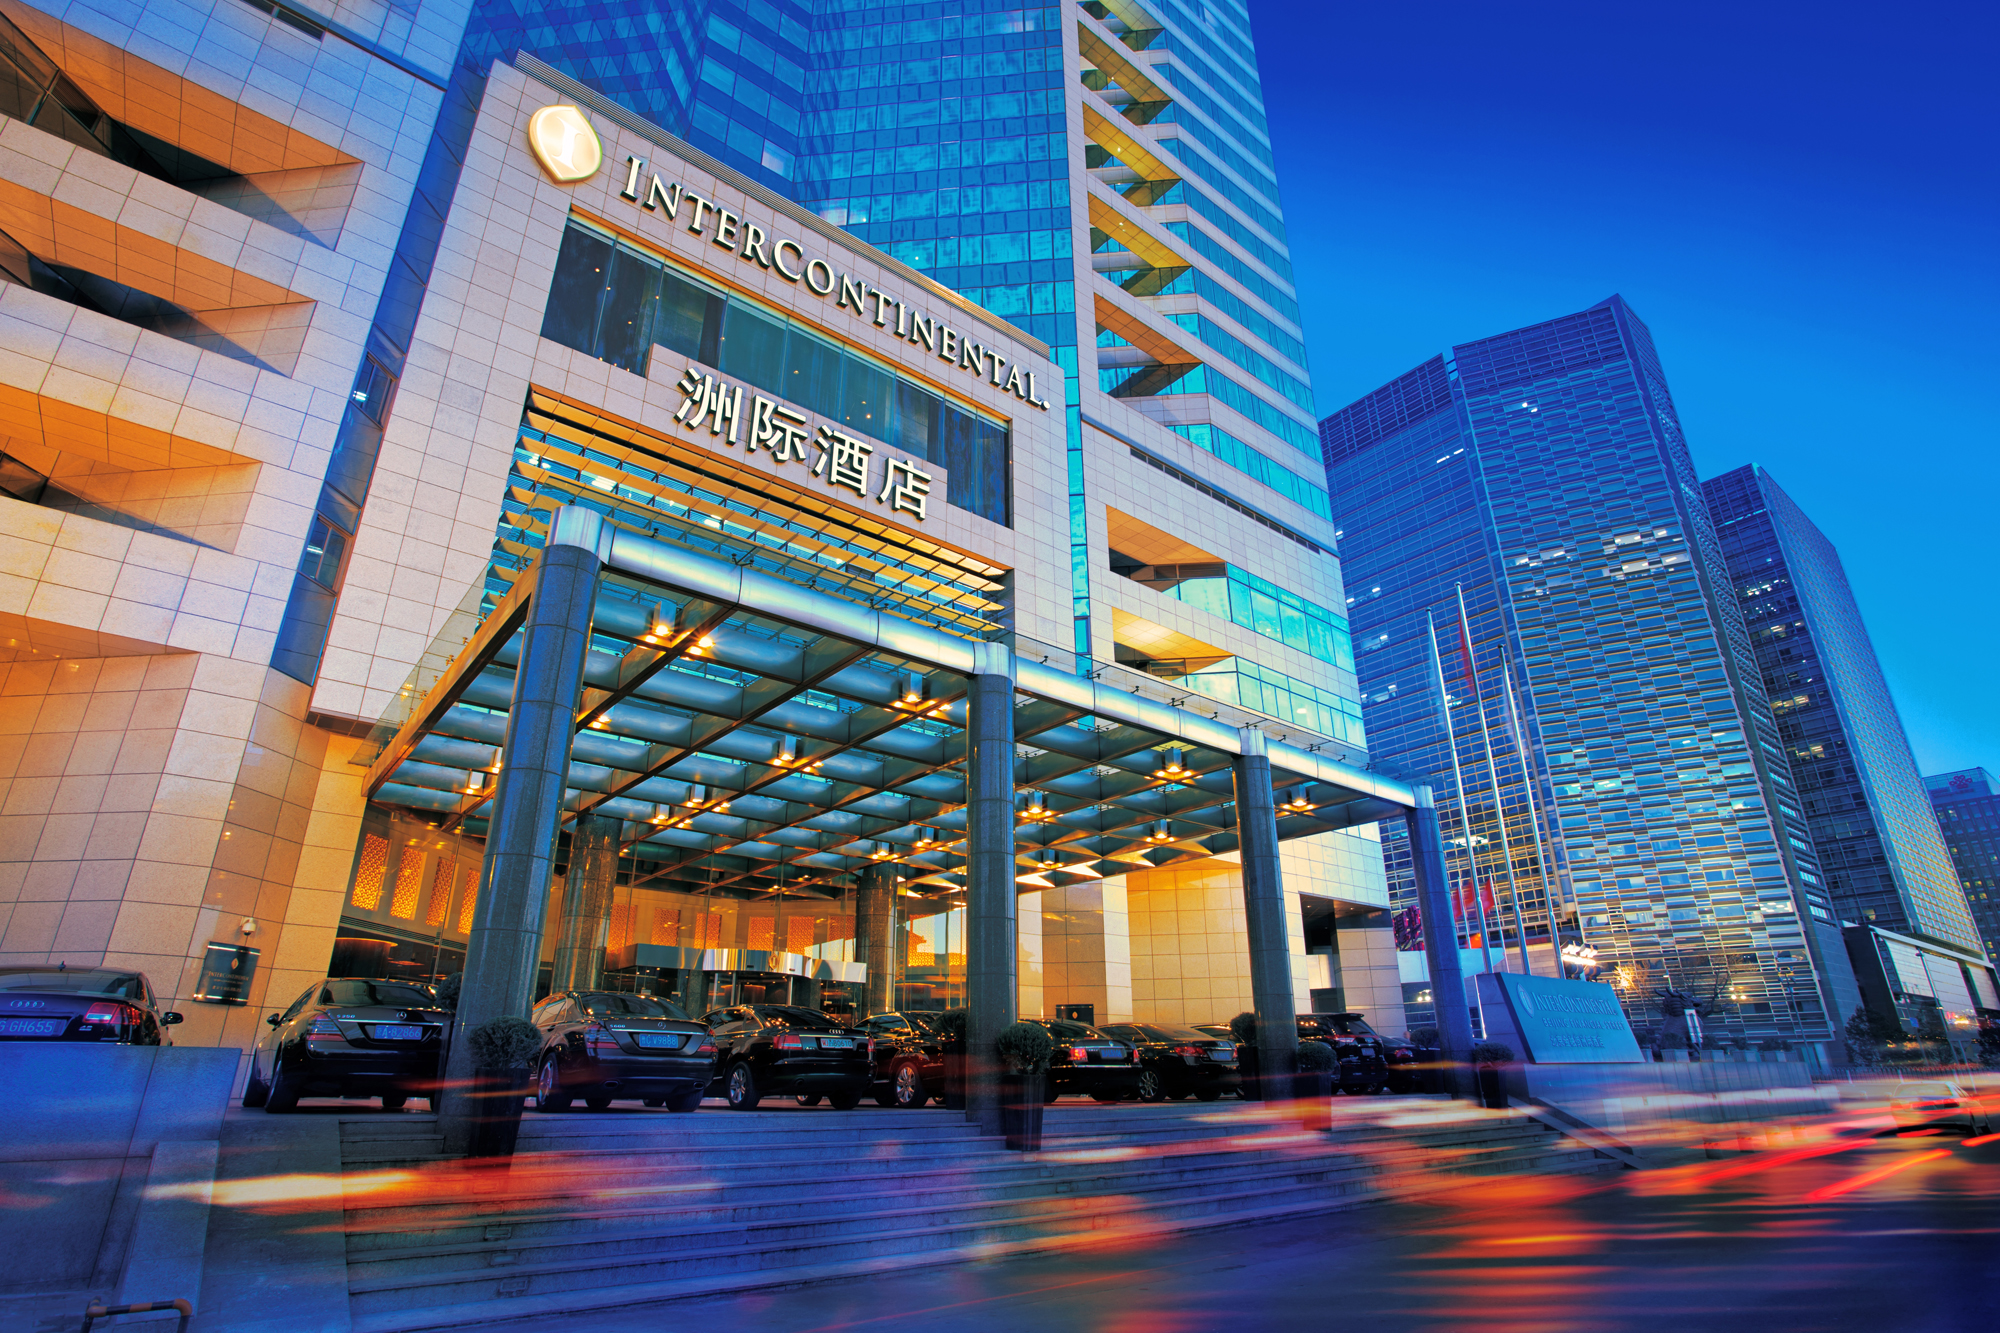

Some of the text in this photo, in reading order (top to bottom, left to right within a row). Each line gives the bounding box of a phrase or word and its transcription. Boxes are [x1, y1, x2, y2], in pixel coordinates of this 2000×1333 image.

[674, 367, 932, 521] 洲际酒店
[1531, 991, 1618, 1016] INTERCONTINENTAL
[1542, 1017, 1625, 1030] BEIJING FINANCIAL STREET
